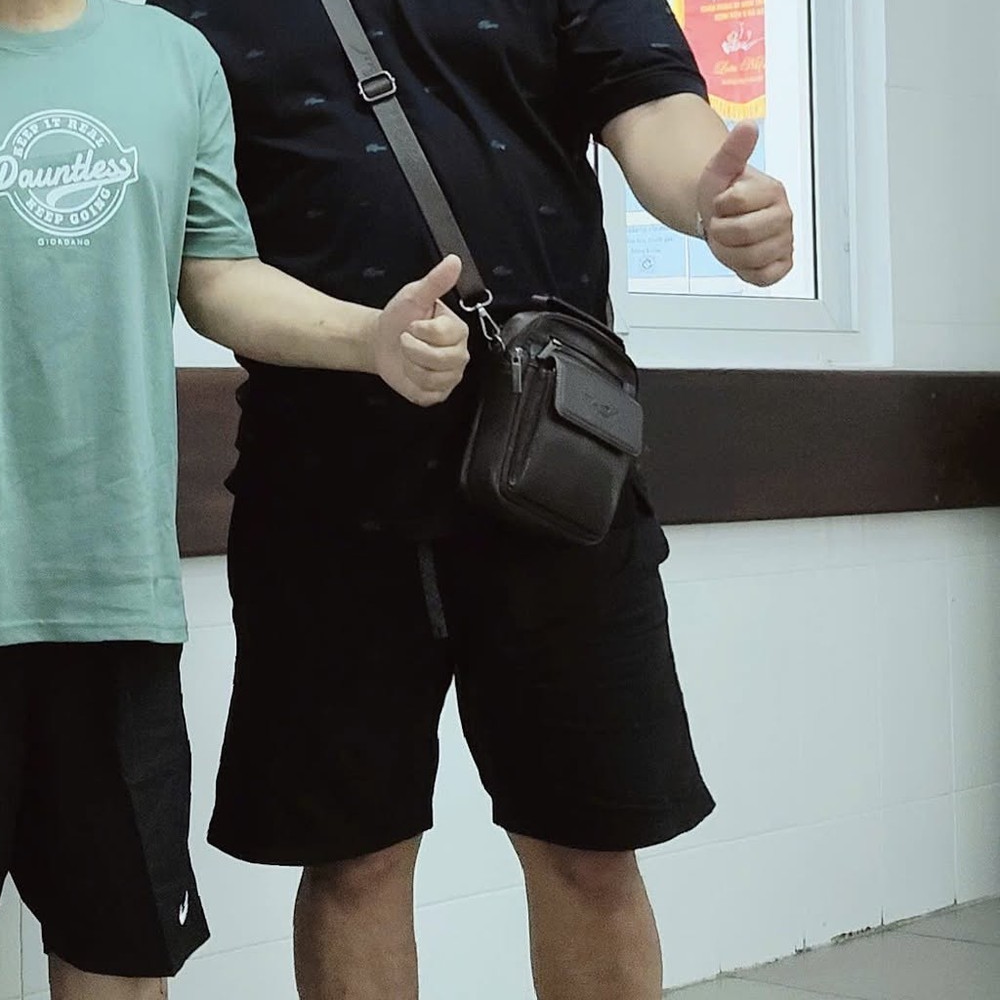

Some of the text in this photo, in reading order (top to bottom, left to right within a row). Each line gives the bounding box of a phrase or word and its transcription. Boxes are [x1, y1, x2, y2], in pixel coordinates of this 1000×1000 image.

[13, 118, 106, 159] KEEP IT REAL
[26, 187, 111, 225] KEEP GOING
[38, 238, 90, 246] GIORDANO
